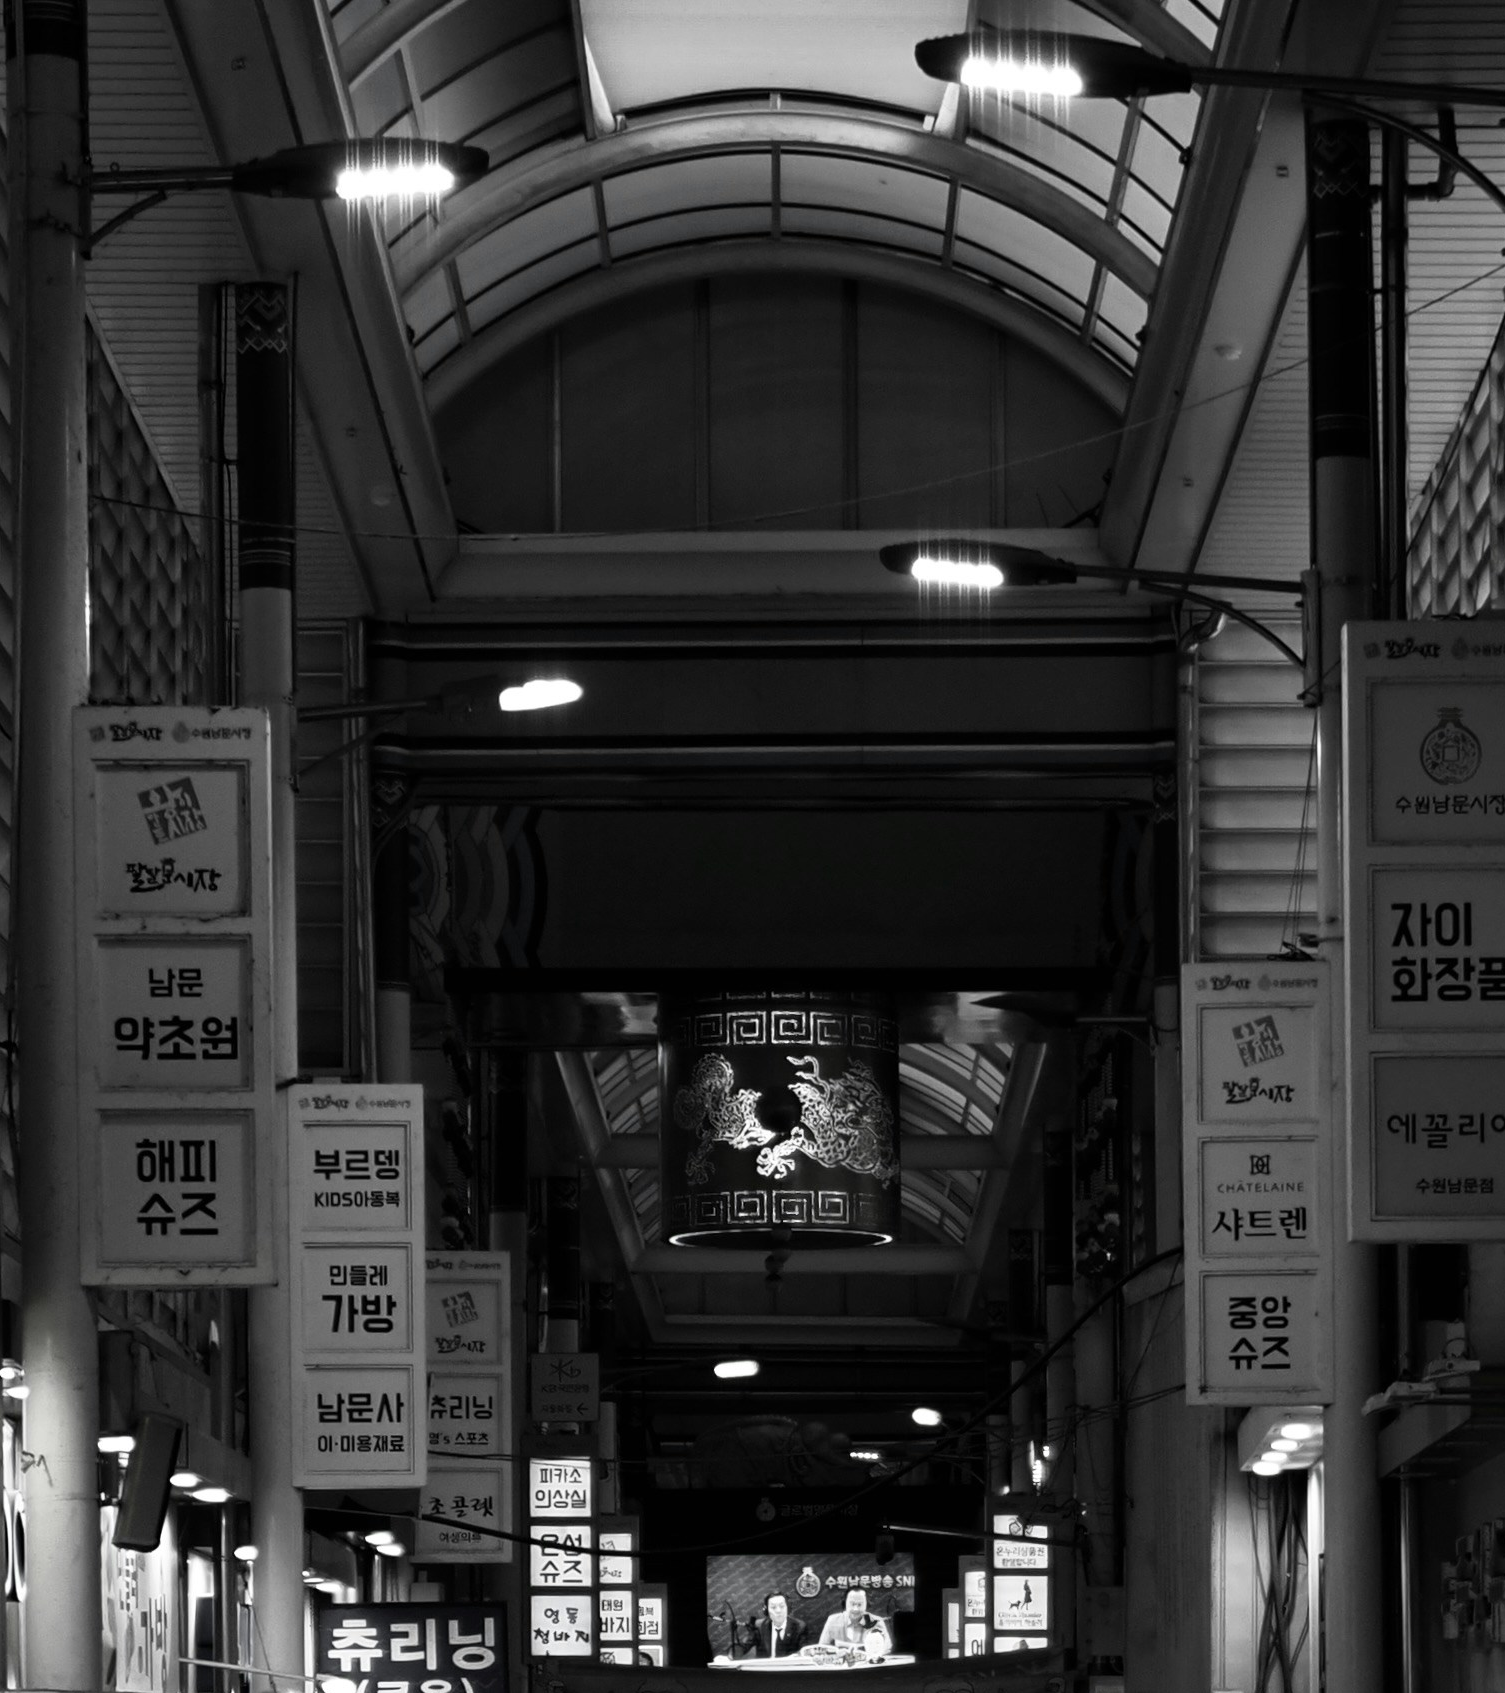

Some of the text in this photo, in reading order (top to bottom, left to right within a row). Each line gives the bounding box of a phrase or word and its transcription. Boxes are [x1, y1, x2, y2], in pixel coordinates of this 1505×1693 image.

[1390, 902, 1473, 949] 자이
[148, 967, 204, 998] 남문
[114, 1016, 239, 1060] 약초원
[136, 1139, 218, 1183] 해피
[313, 1150, 400, 1180] 부르뎅
[1415, 1178, 1494, 1194] 수원남문점
[314, 1190, 400, 1208] KIDS아동복
[136, 1192, 219, 1236] 슈즈
[1212, 1207, 1307, 1241] 샤트렌
[330, 1265, 388, 1287] 민들레
[322, 1295, 397, 1334] 가방
[1228, 1295, 1292, 1330] 중앙
[1228, 1336, 1292, 1371] 슈즈
[317, 1393, 405, 1424] 남문사
[430, 1395, 493, 1420] 츄리닝
[454, 1431, 489, 1445] 스포츠
[539, 1468, 583, 1483] 피카소
[534, 1490, 587, 1508] 의상실
[541, 1534, 583, 1557] 은성
[539, 1560, 583, 1584] 슈즈
[825, 1575, 894, 1589] 수원남문방송
[543, 1607, 579, 1625] 영동
[600, 1616, 630, 1634] 바지
[328, 1617, 495, 1673] 츄리닝
[533, 1627, 590, 1645] 청바지
